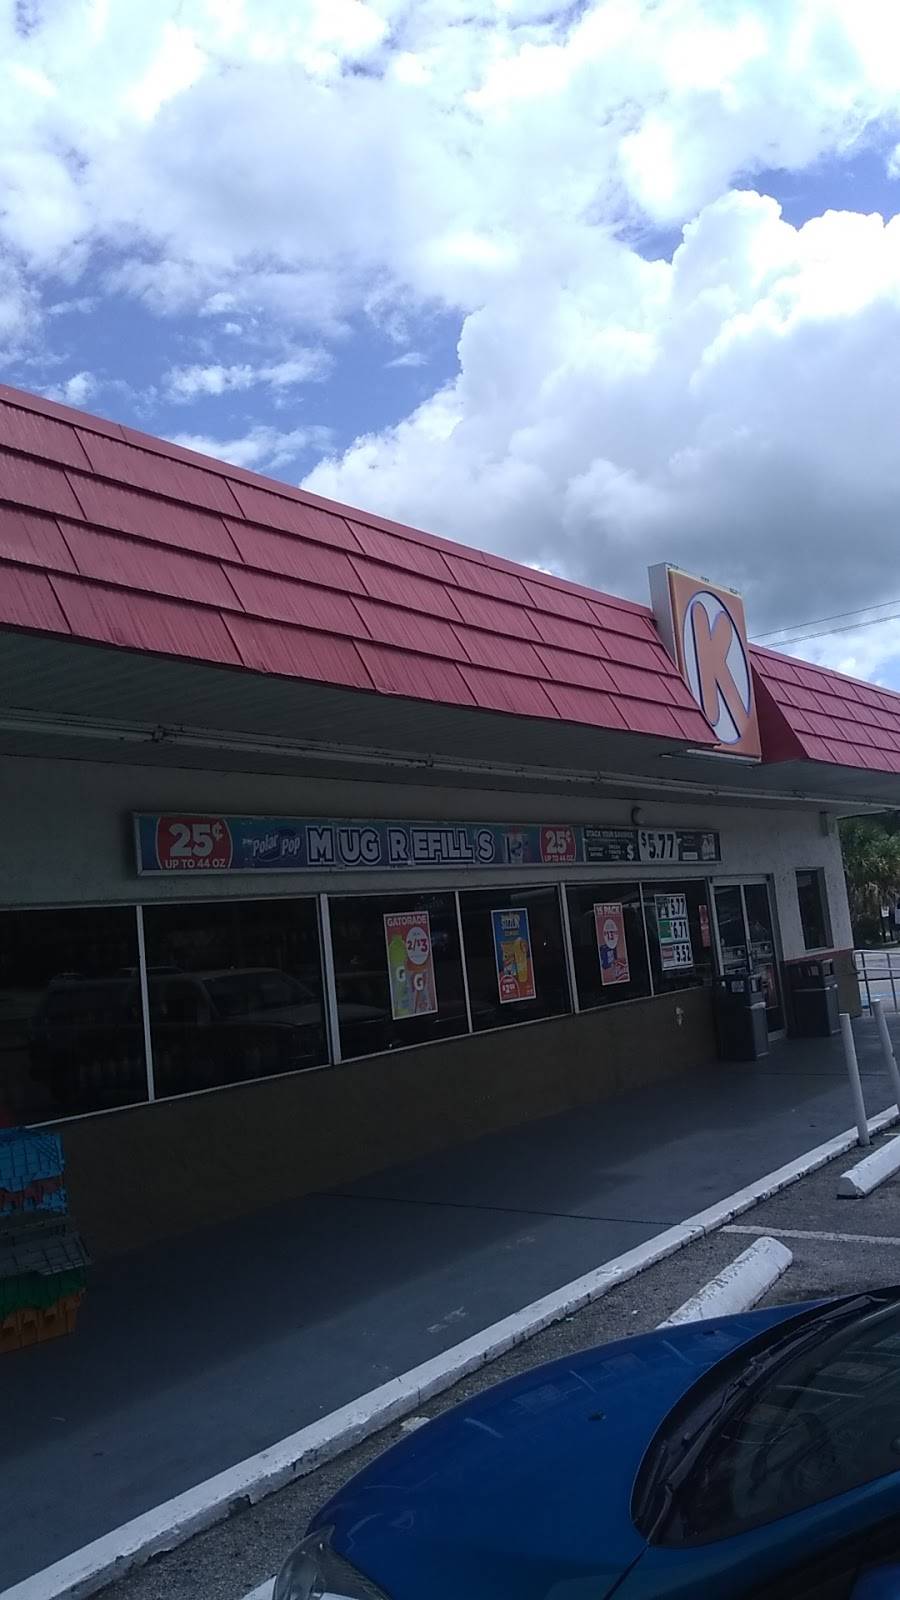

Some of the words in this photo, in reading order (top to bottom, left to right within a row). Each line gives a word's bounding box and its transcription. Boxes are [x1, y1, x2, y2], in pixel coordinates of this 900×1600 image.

[690, 600, 749, 740] K
[169, 822, 225, 857] 25¢
[253, 833, 279, 856] Polar
[282, 836, 300, 856] Pop
[306, 826, 381, 865] MUG
[387, 828, 495, 863] REFILLS
[545, 830, 572, 854] 25¢
[165, 859, 179, 869] UP
[182, 859, 196, 868] TO
[197, 859, 211, 868] 44
[212, 858, 226, 868] OZ
[387, 915, 427, 927] GATORADE
